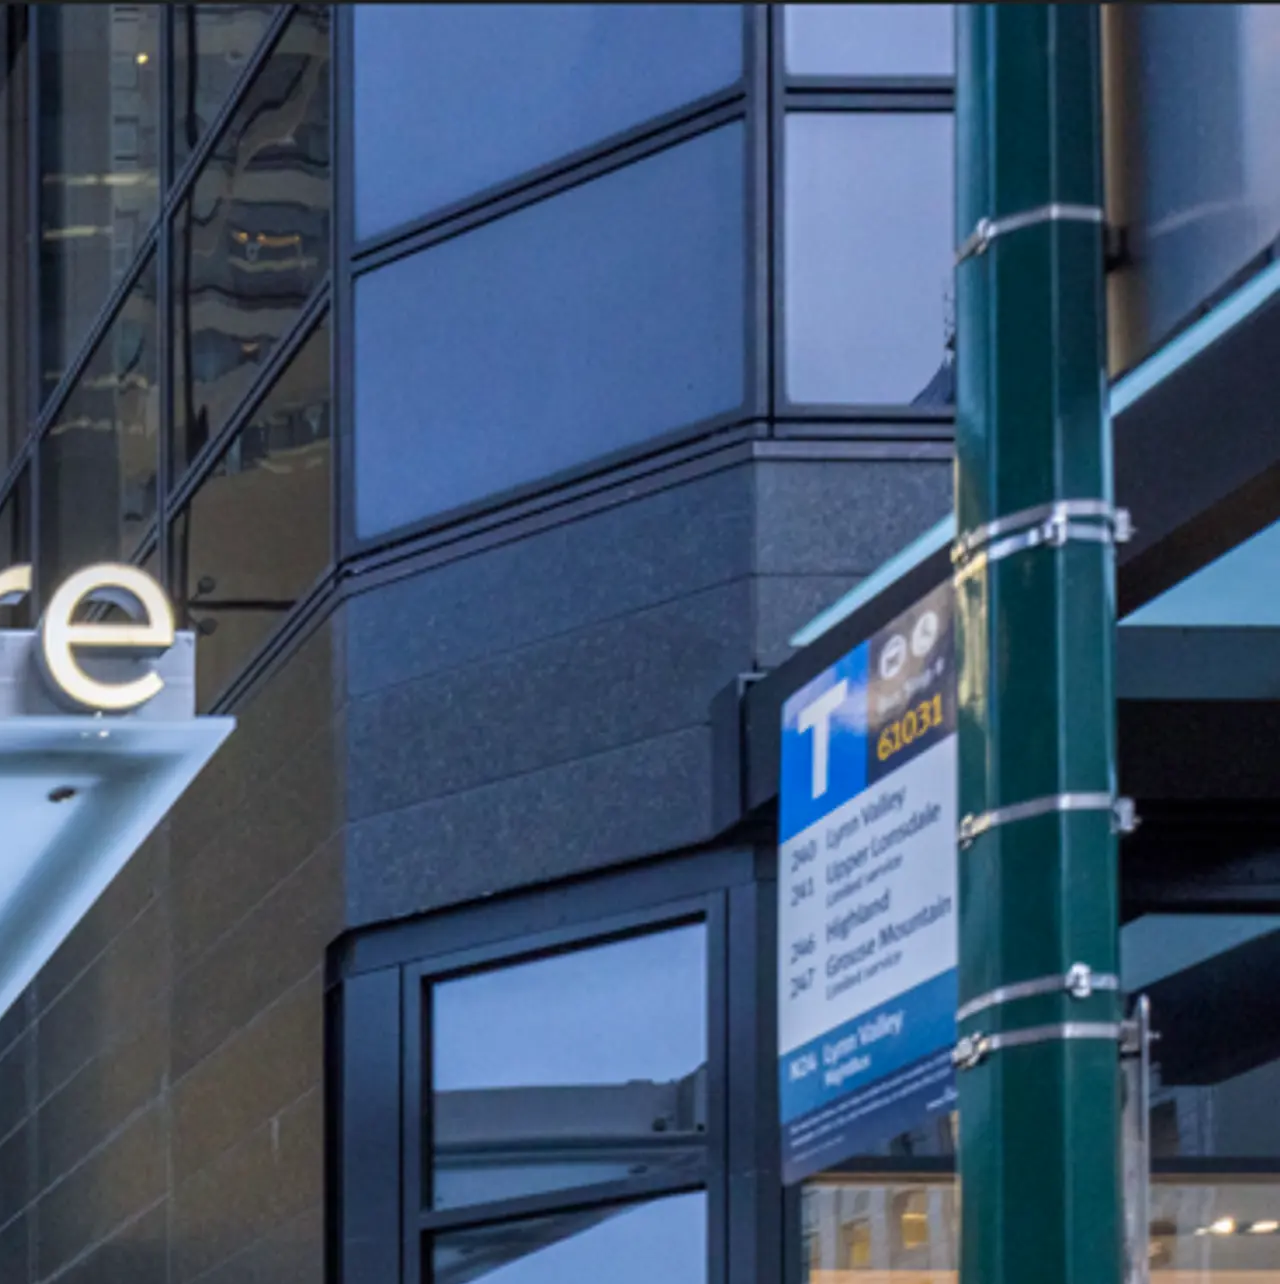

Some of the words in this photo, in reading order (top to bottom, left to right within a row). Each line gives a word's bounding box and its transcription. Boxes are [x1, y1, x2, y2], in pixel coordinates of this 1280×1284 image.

[797, 677, 848, 799] T
[877, 694, 943, 761] 61031
[826, 815, 860, 849] Lynn
[860, 786, 906, 827] Valley
[826, 847, 868, 885] Upper
[870, 800, 942, 857] Lonsdale
[826, 887, 891, 943] Highland
[826, 938, 876, 979] Grouse
[878, 894, 952, 949] Mountain
[858, 1009, 906, 1046] Valley
